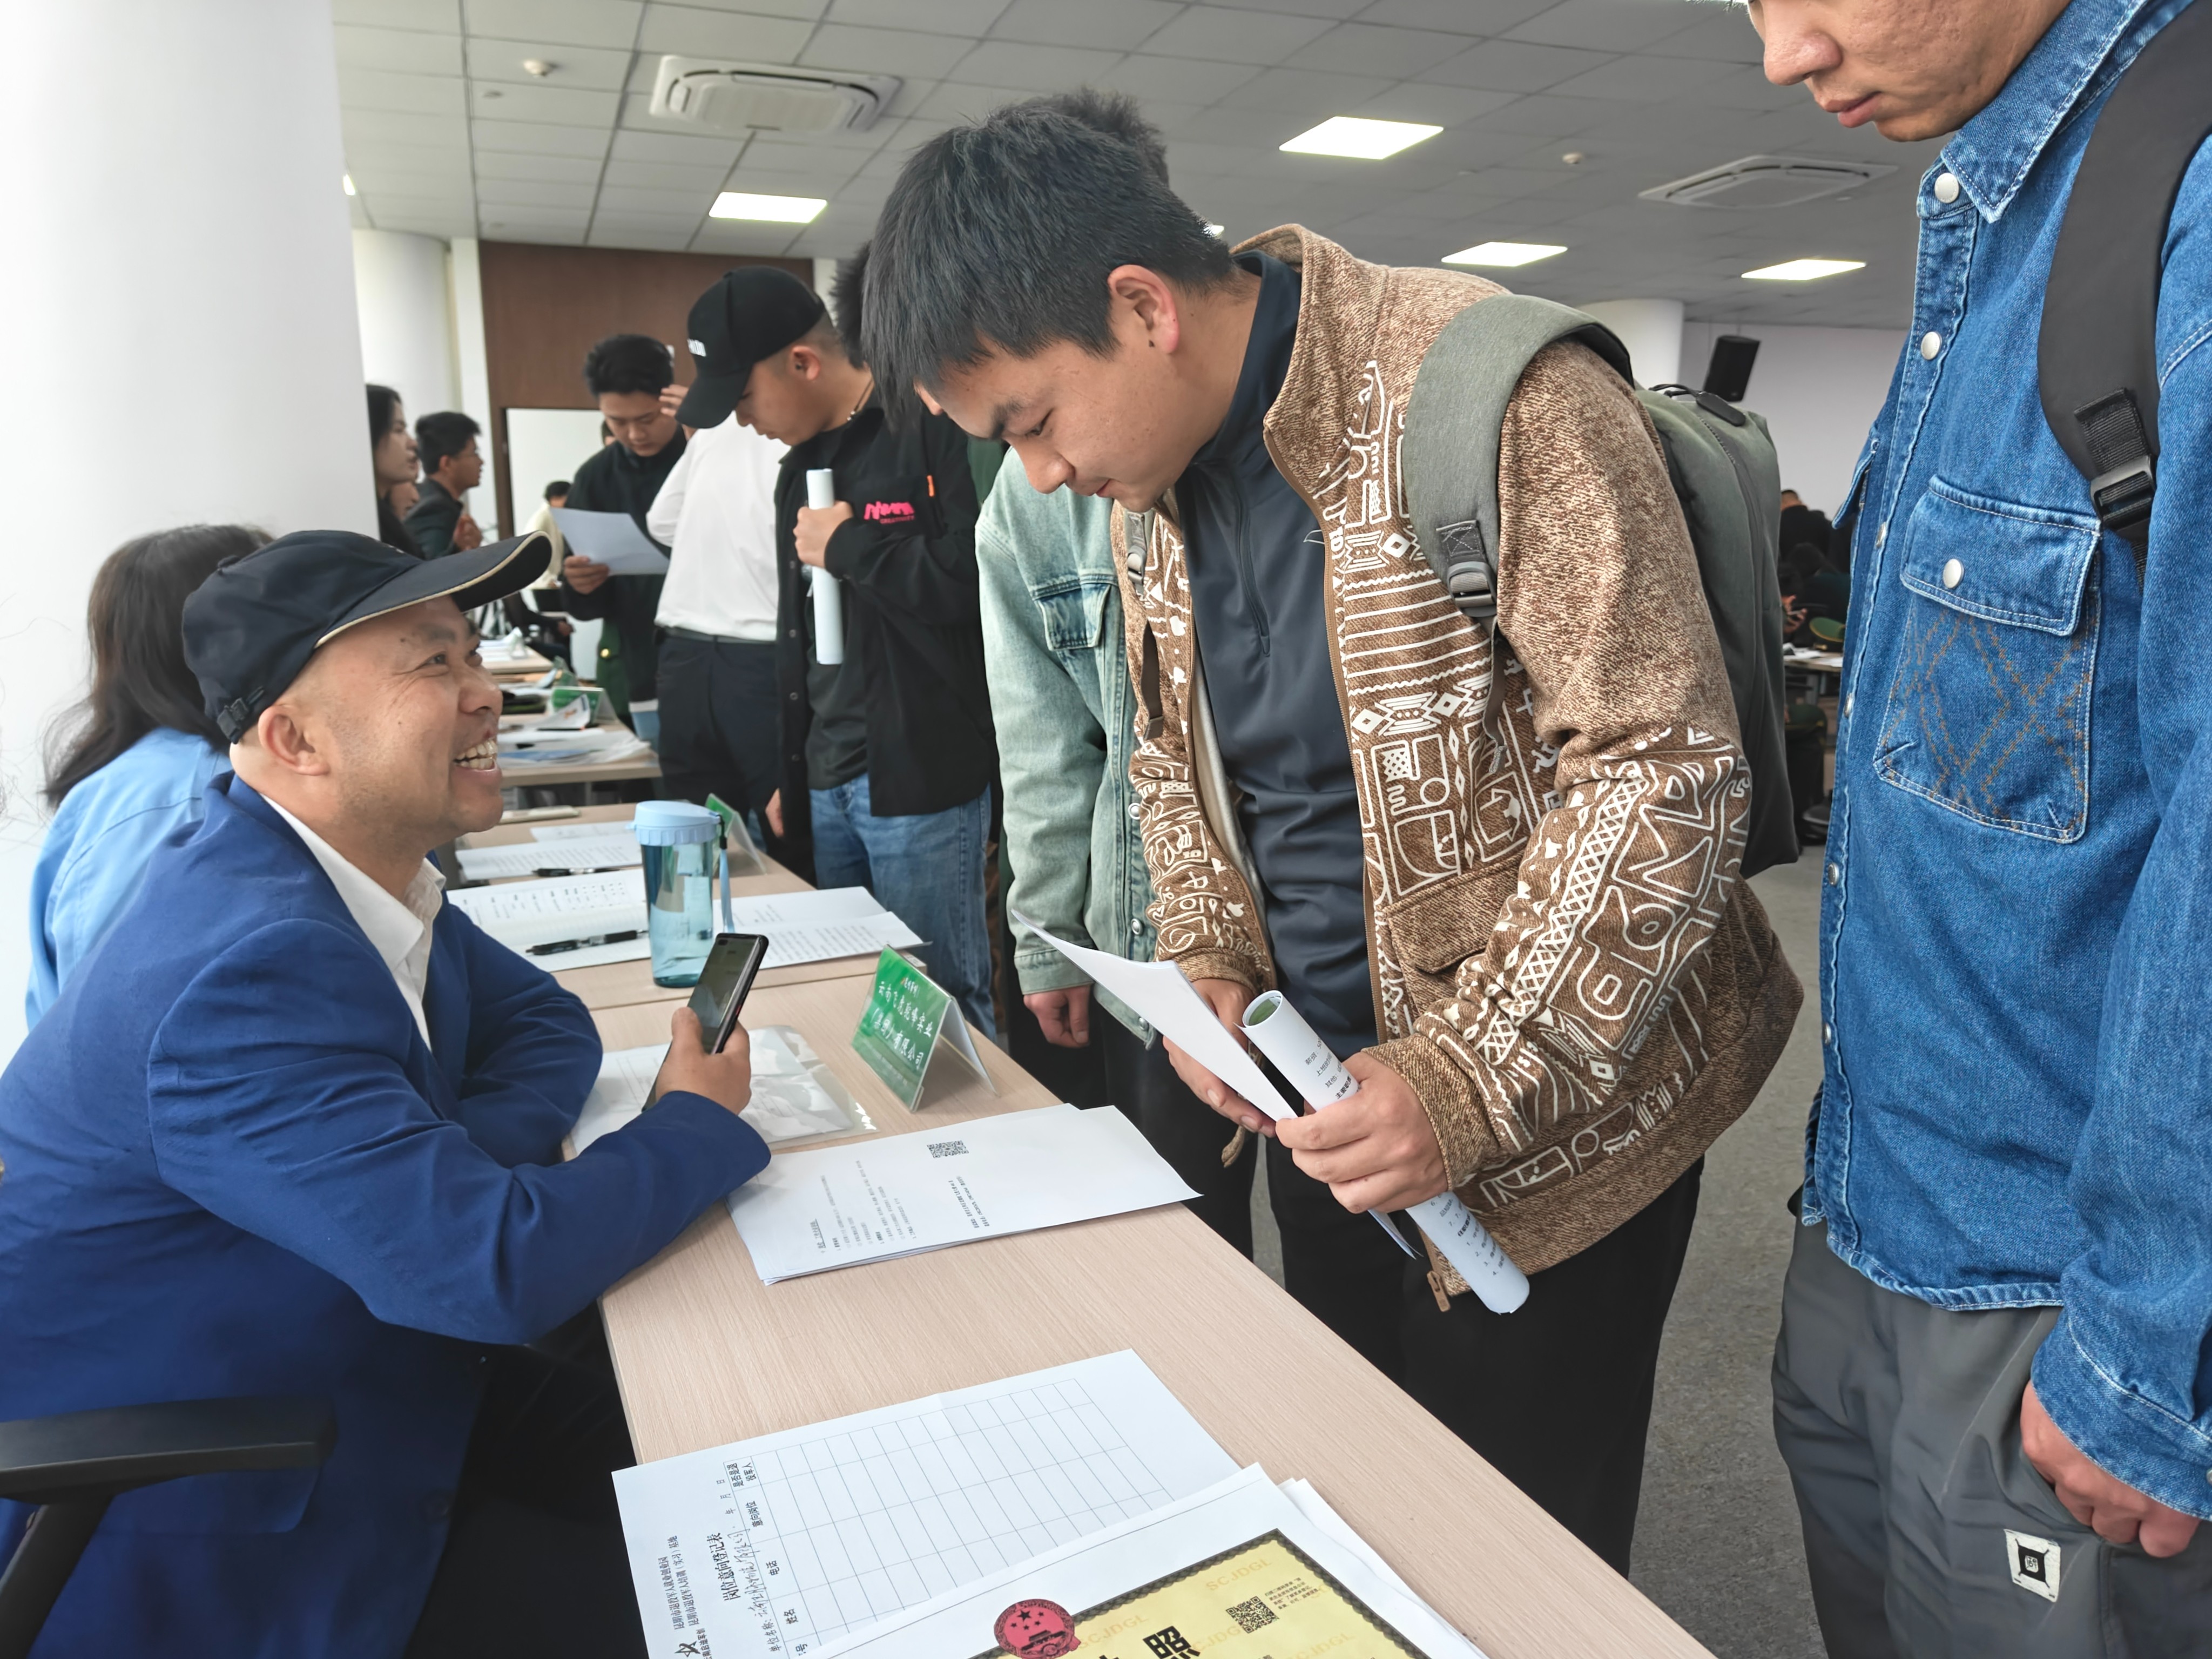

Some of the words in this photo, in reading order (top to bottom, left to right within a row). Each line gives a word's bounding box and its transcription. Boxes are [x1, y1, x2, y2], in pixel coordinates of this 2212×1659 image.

[726, 1462, 745, 1487] 是否是退
[741, 1462, 757, 1482] 役军人
[745, 1500, 764, 1527] 意向岗位
[706, 1533, 741, 1601] 岗位意向登记表
[766, 1560, 780, 1576] 电话
[658, 1556, 685, 1630] 昆明市退役军人就业创业园
[784, 1608, 799, 1624] 姓名
[795, 1643, 808, 1656] 号
